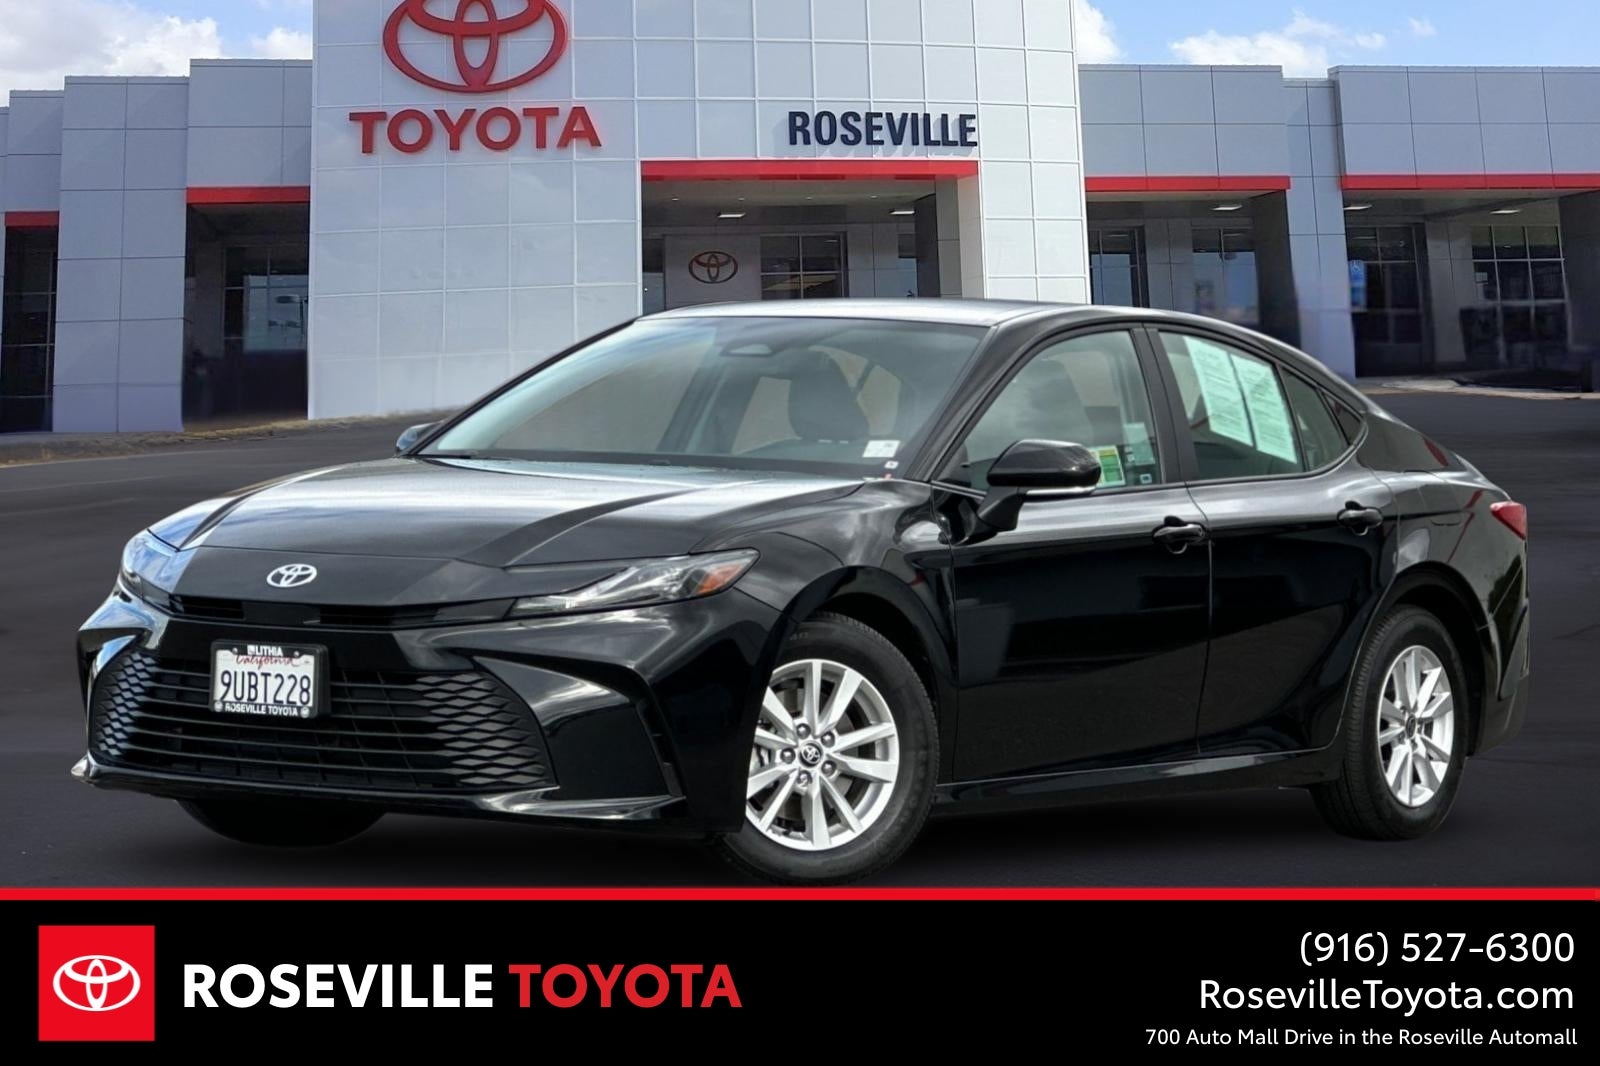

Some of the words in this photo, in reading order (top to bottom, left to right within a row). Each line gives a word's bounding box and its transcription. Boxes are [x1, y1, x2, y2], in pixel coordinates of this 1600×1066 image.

[349, 105, 602, 155] TOYOTA
[788, 110, 979, 148] ROSEVILLE
[236, 655, 297, 669] California
[255, 645, 284, 657] LITHIA
[220, 669, 311, 706] 9UBT228
[225, 703, 267, 714] ROSEVILLE
[268, 706, 299, 717] TOYOTA
